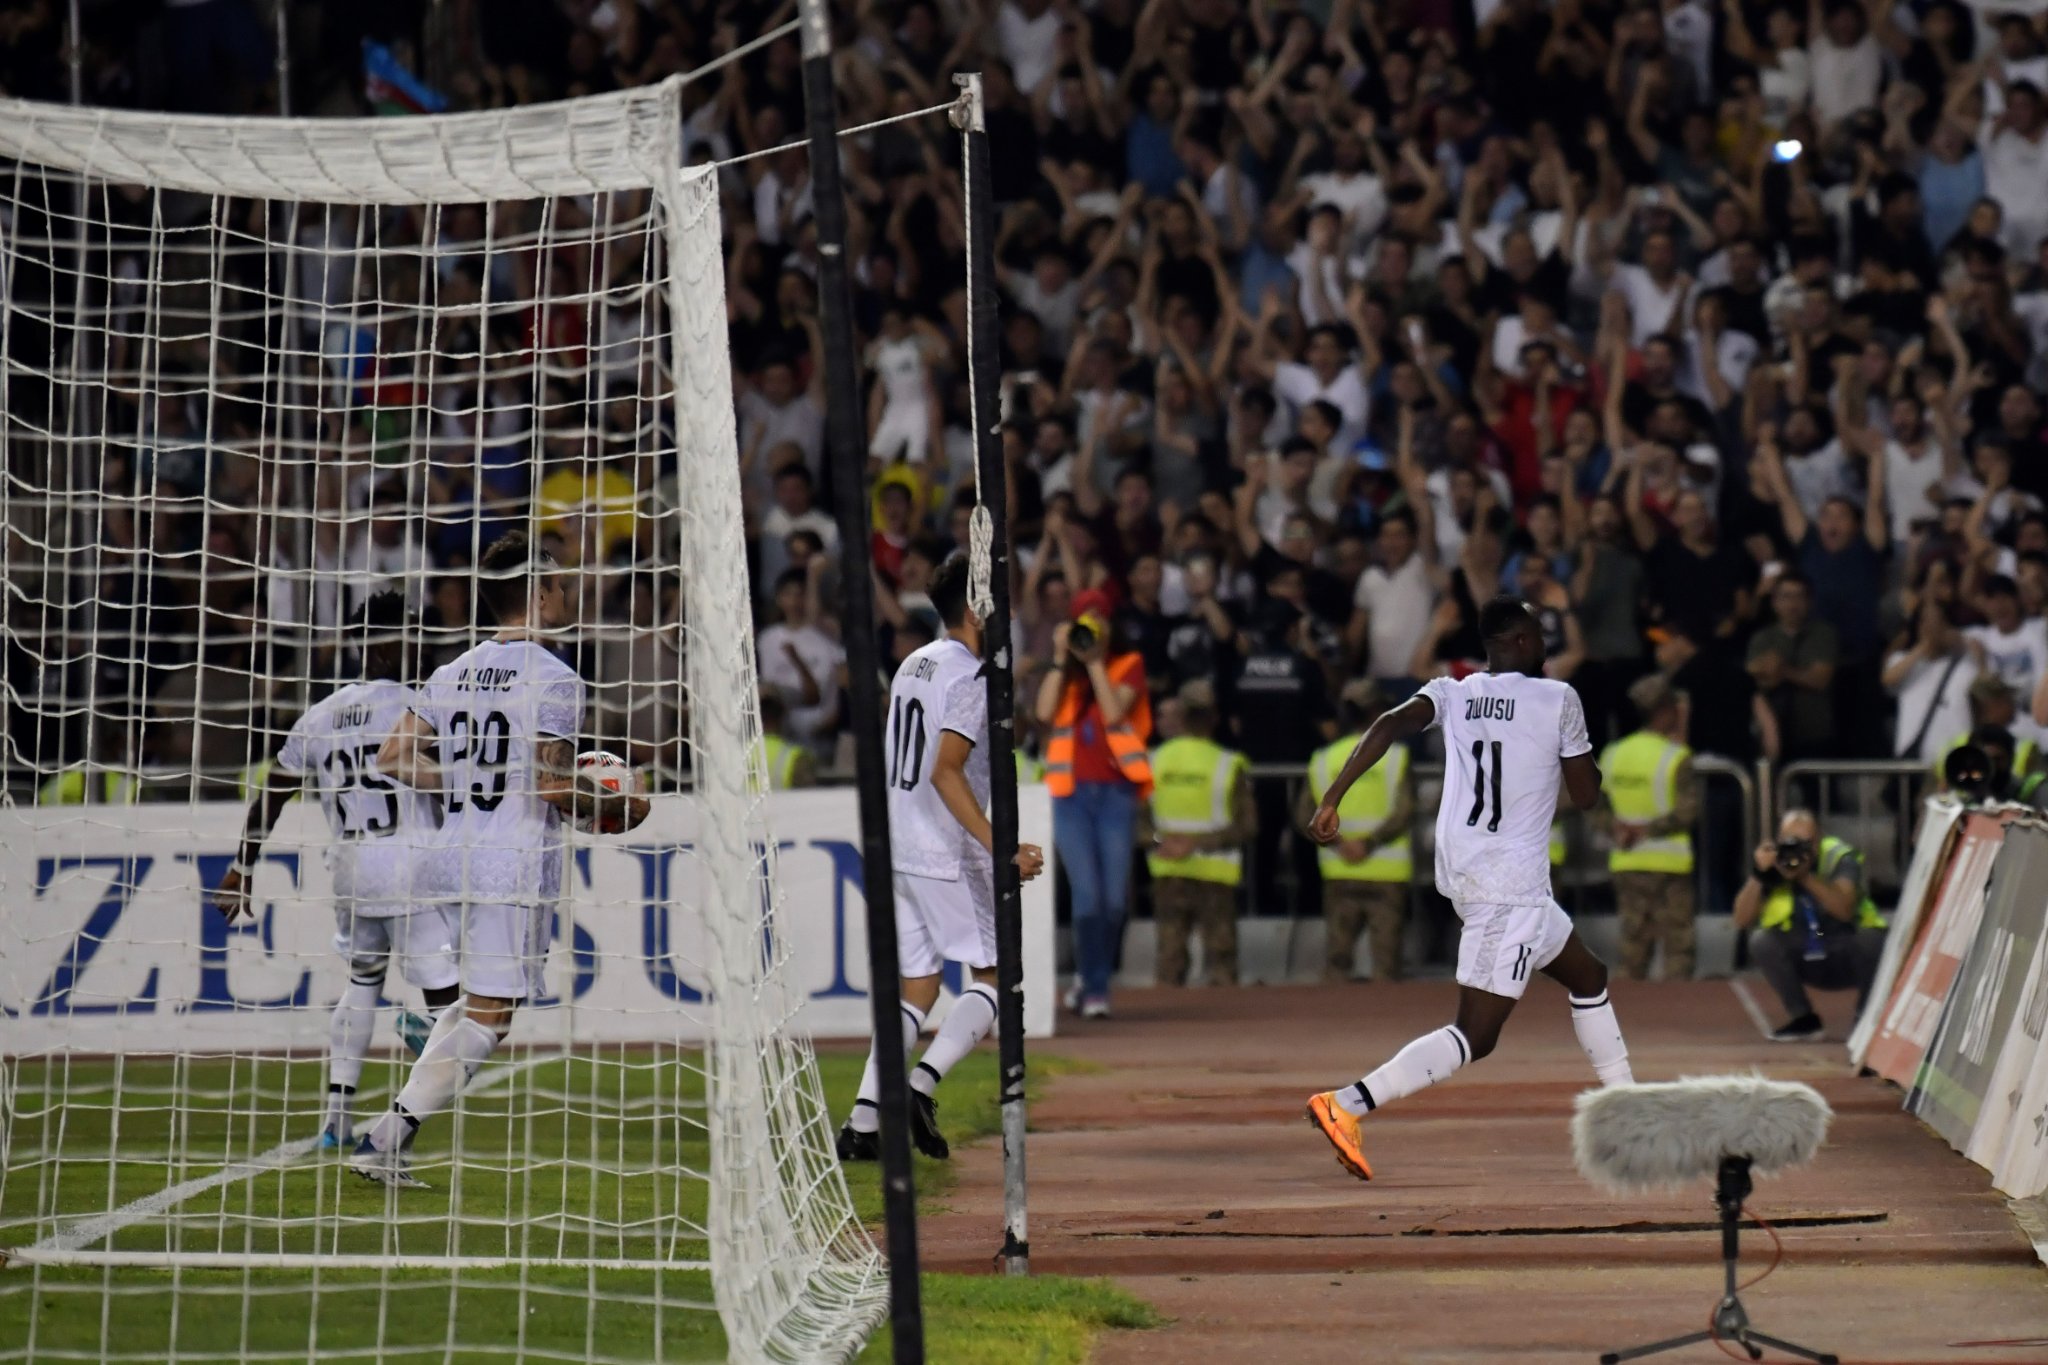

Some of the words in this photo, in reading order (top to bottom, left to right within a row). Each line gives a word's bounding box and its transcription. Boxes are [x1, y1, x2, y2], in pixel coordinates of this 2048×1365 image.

[891, 695, 925, 791] 10
[1465, 696, 1516, 722] OWUSU
[323, 743, 398, 838] 25
[449, 710, 510, 814] 29
[1466, 740, 1503, 833] 11
[1511, 943, 1532, 982] 11
